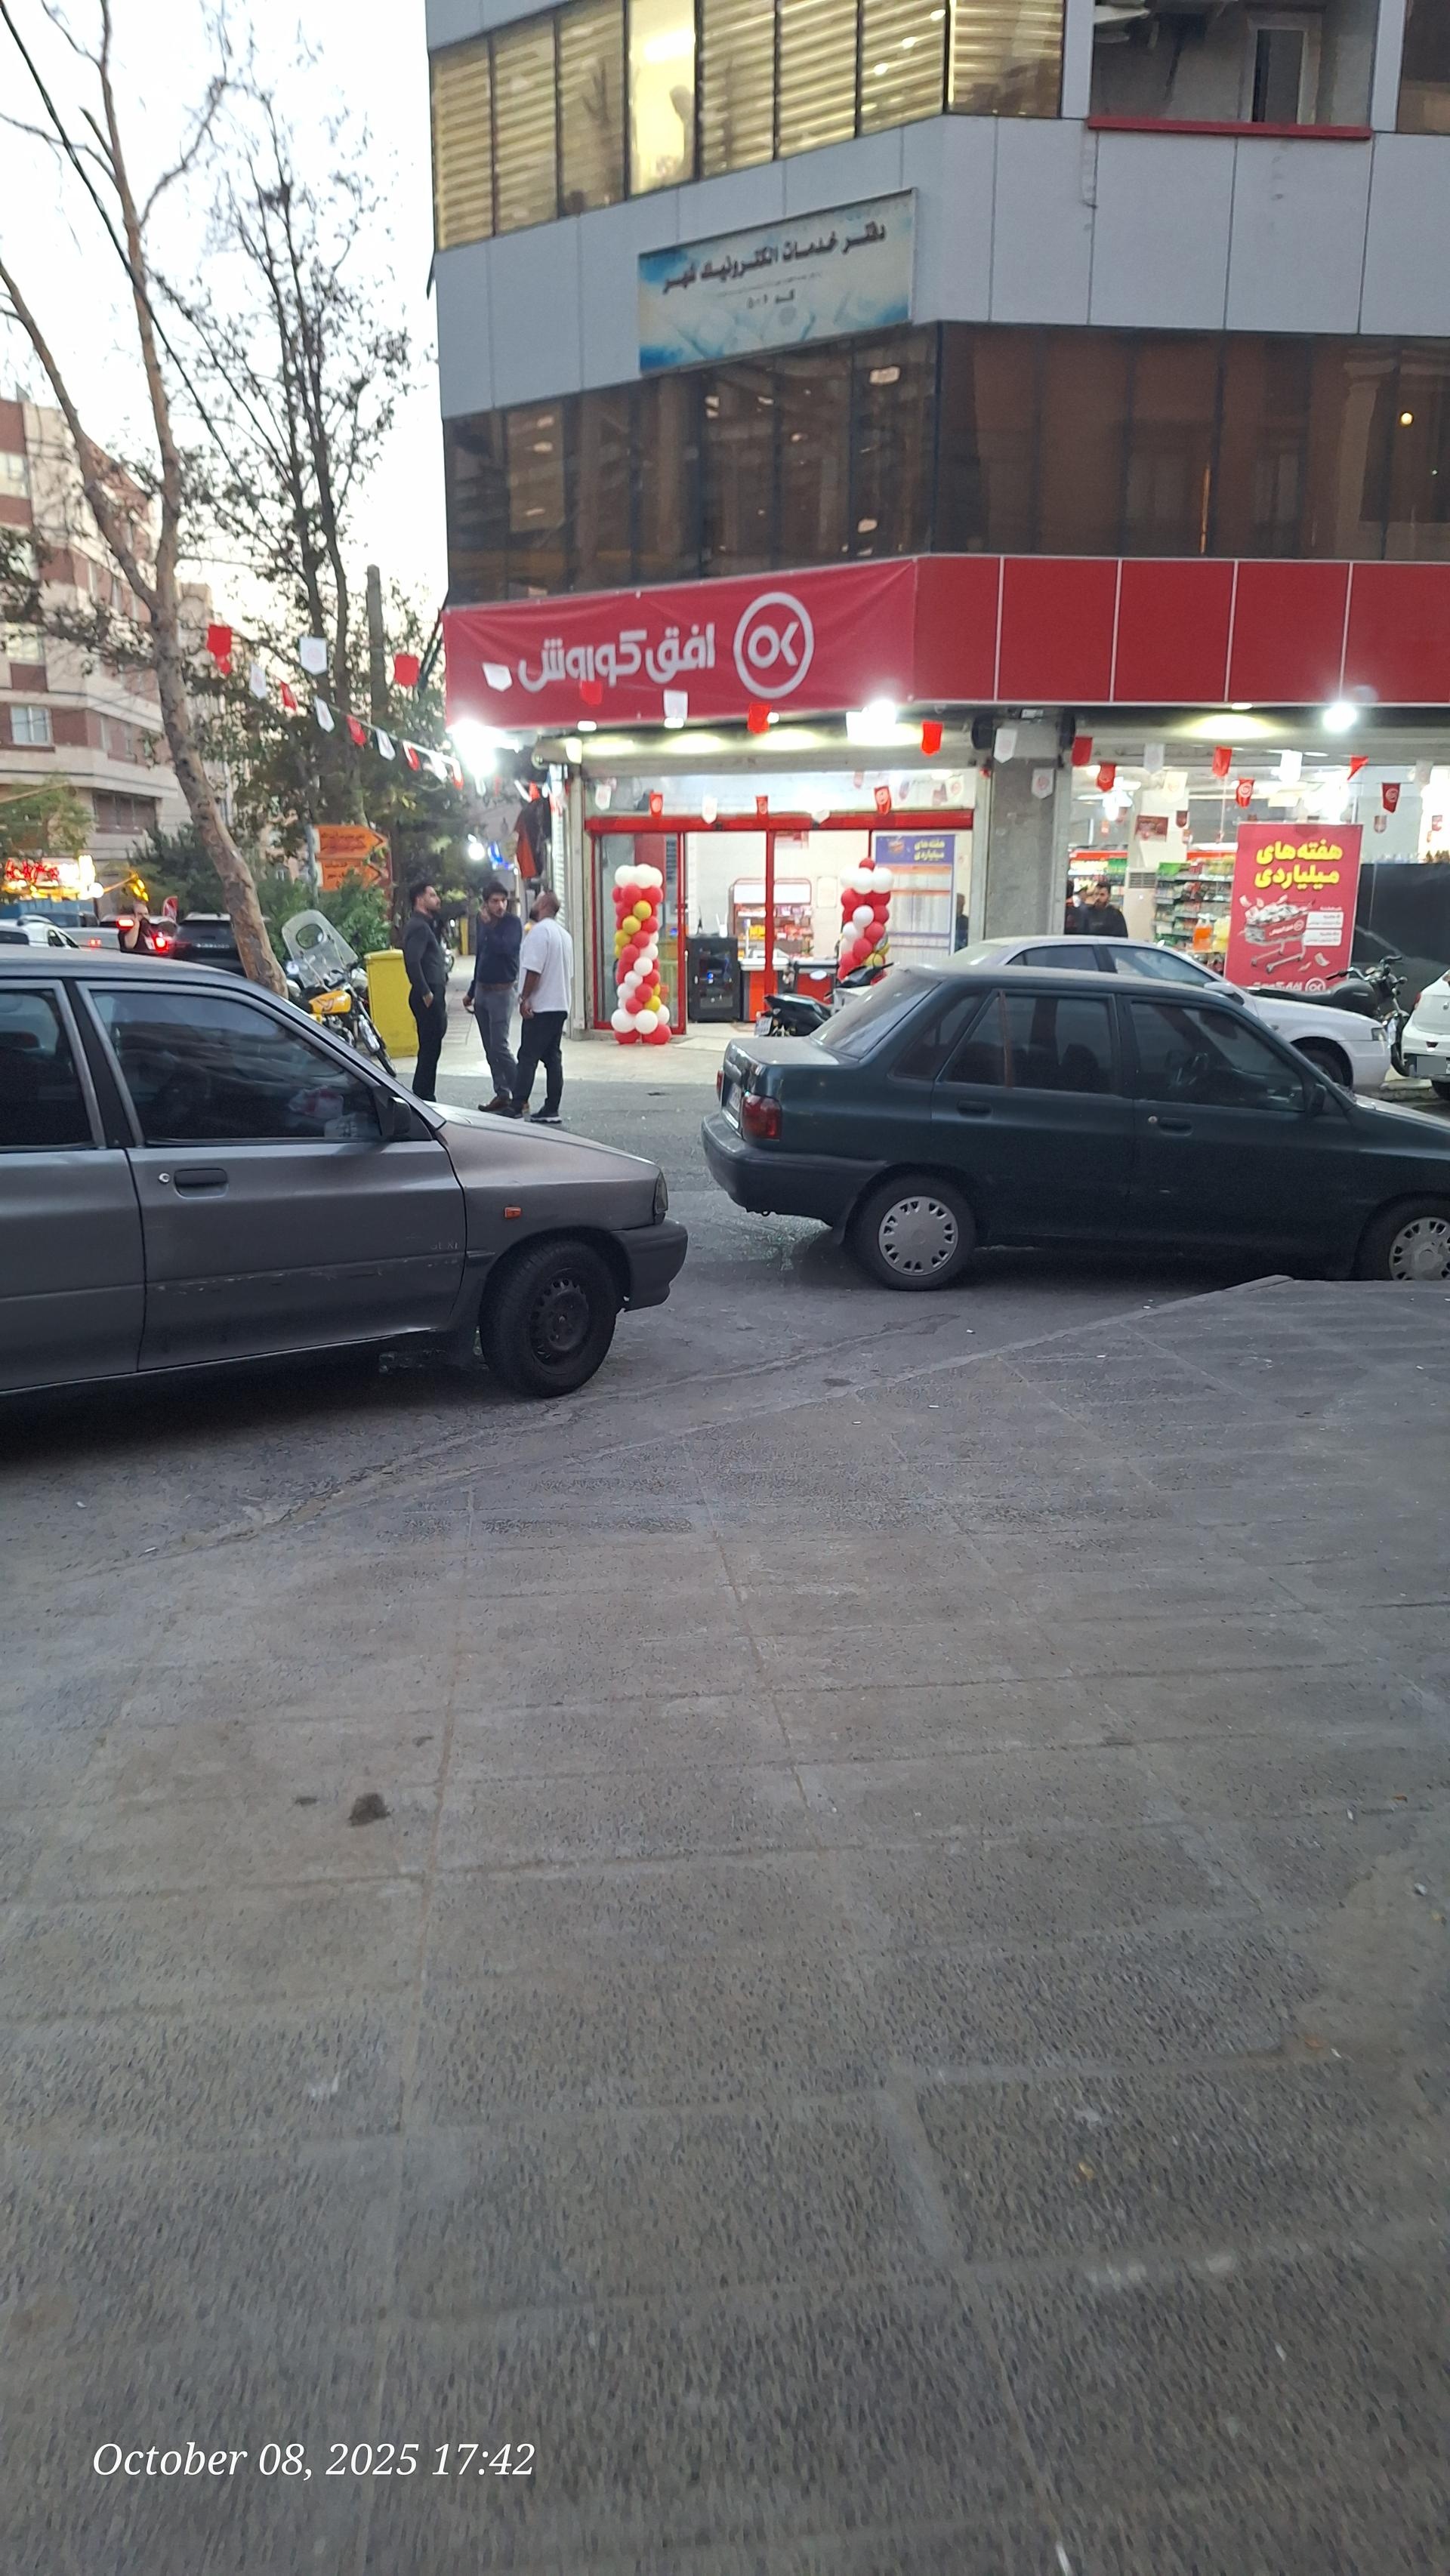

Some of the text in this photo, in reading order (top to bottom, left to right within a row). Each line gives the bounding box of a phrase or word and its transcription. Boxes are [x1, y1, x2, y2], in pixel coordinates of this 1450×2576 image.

[782, 230, 838, 262] خدمات
[843, 220, 887, 254] دفتر
[518, 623, 716, 693] افق کوروش
[748, 621, 799, 669] OK
[1254, 864, 1340, 890] میلیاردی
